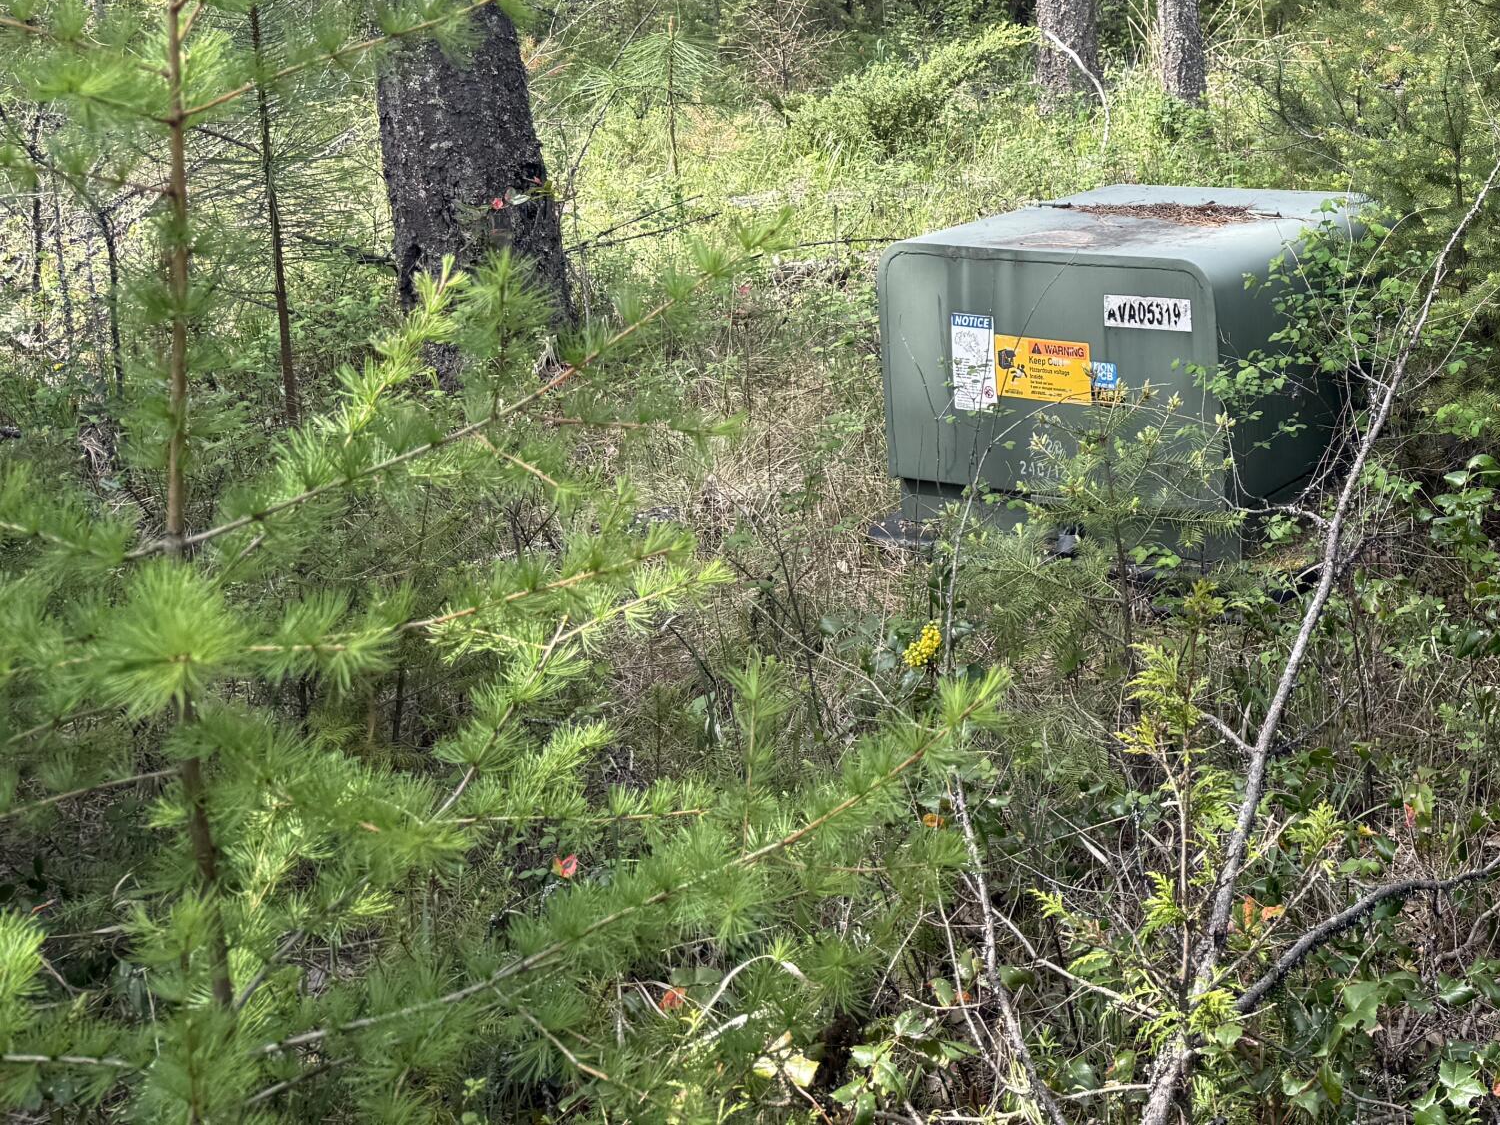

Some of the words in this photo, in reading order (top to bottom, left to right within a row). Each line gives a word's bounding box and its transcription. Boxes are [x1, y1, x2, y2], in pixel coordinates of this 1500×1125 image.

[1107, 301, 1181, 326] AVA05319
[954, 315, 990, 328] NOTICE
[1044, 344, 1085, 358] WARNING
[1028, 356, 1046, 367] Keep
[1053, 369, 1070, 377] voltage
